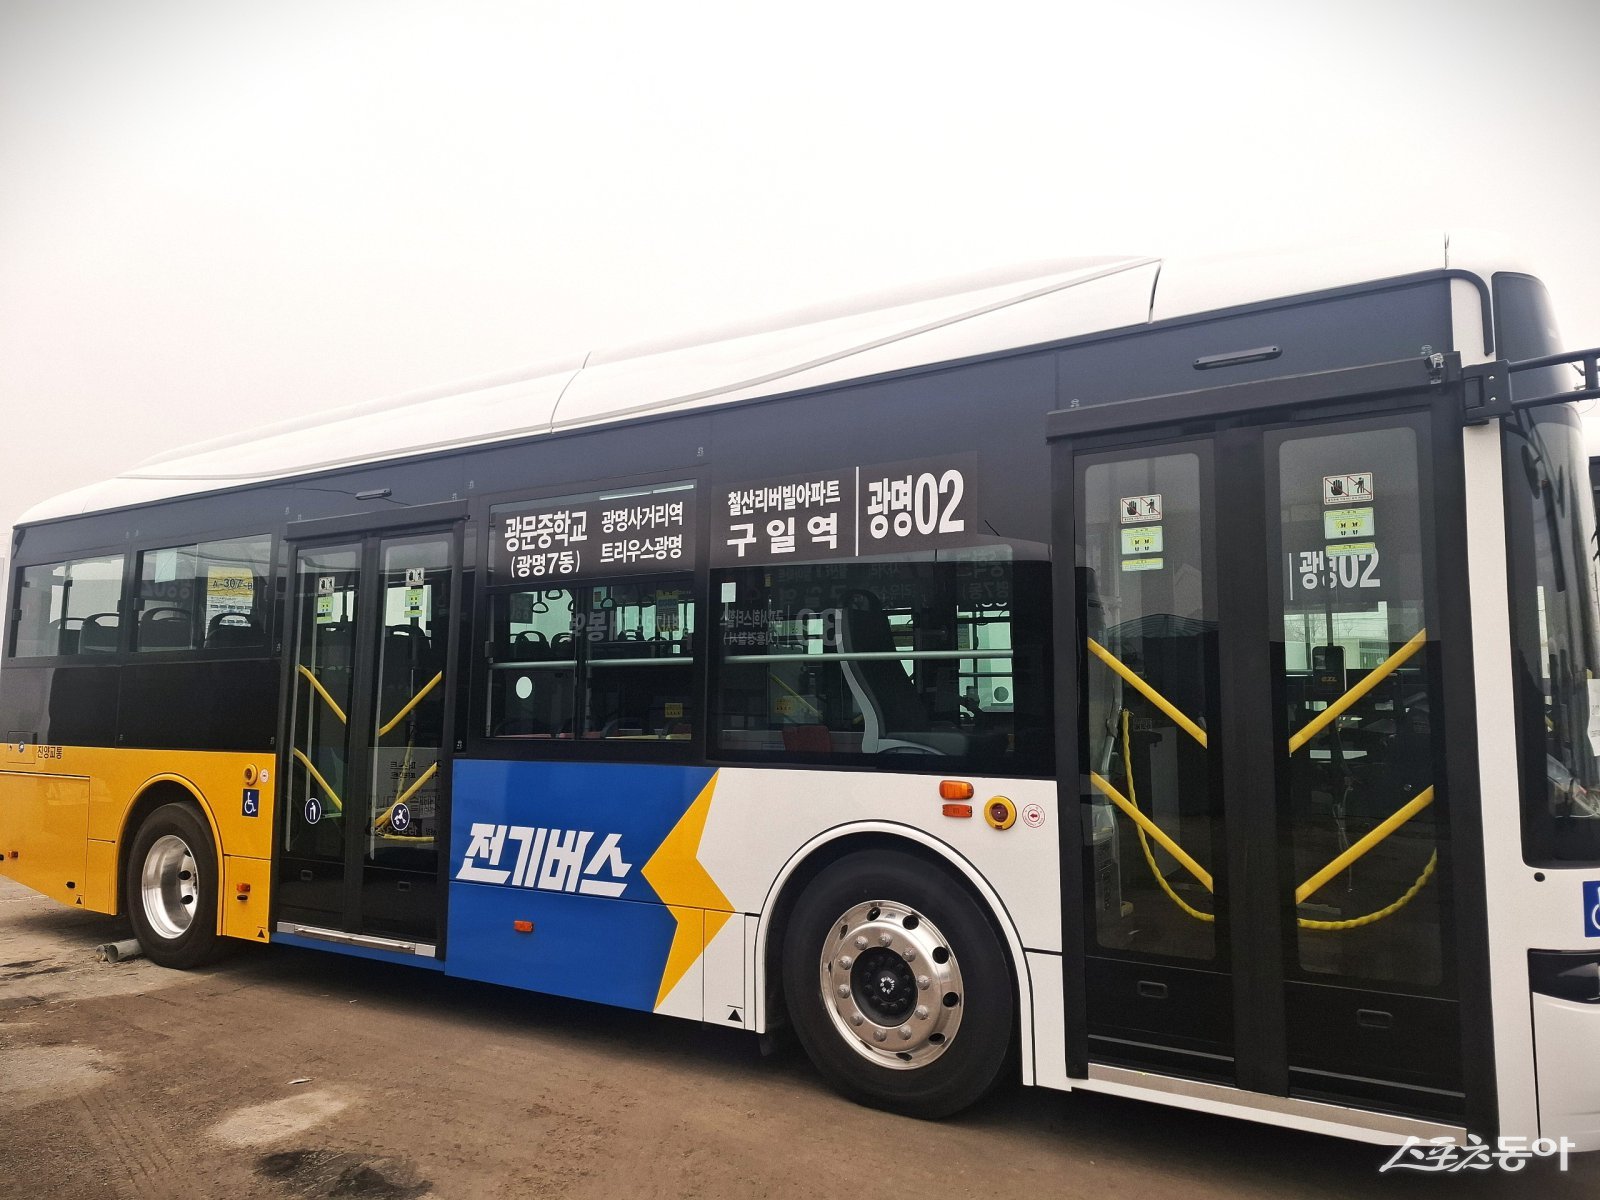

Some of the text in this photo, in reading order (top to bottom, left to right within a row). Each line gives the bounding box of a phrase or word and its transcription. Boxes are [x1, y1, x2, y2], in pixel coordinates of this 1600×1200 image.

[728, 480, 840, 516] 철산리버빌아파트
[867, 469, 965, 539] 광명02
[504, 510, 588, 552] 광문중학교
[601, 501, 683, 533] 광명사거리역
[511, 550, 581, 578] (광명7동)
[600, 534, 682, 563] 트리우스광명
[36, 745, 63, 760] 진양교통
[455, 822, 633, 898] 전기버스
